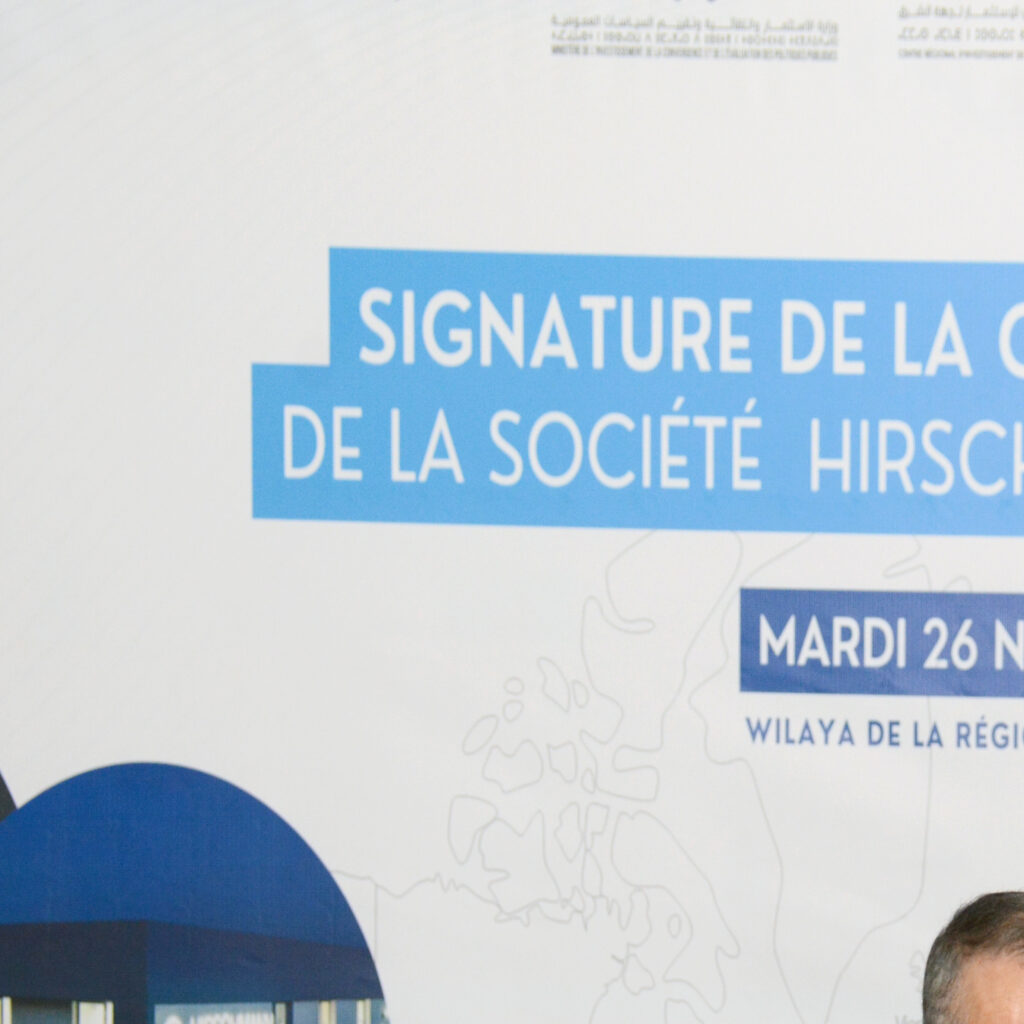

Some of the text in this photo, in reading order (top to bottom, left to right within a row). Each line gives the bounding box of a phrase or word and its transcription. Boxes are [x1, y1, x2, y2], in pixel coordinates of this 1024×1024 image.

[357, 286, 754, 375] SIGNATURE
[779, 298, 867, 376] DE
[892, 300, 975, 378] LA
[282, 404, 363, 481] DE
[389, 407, 464, 485] LA
[488, 396, 762, 492] SOCIÉTÉ
[758, 614, 907, 669] MARDI
[923, 616, 979, 672] 26
[745, 717, 855, 745] WILAYA
[867, 719, 901, 747] DE
[913, 721, 944, 748] LA
